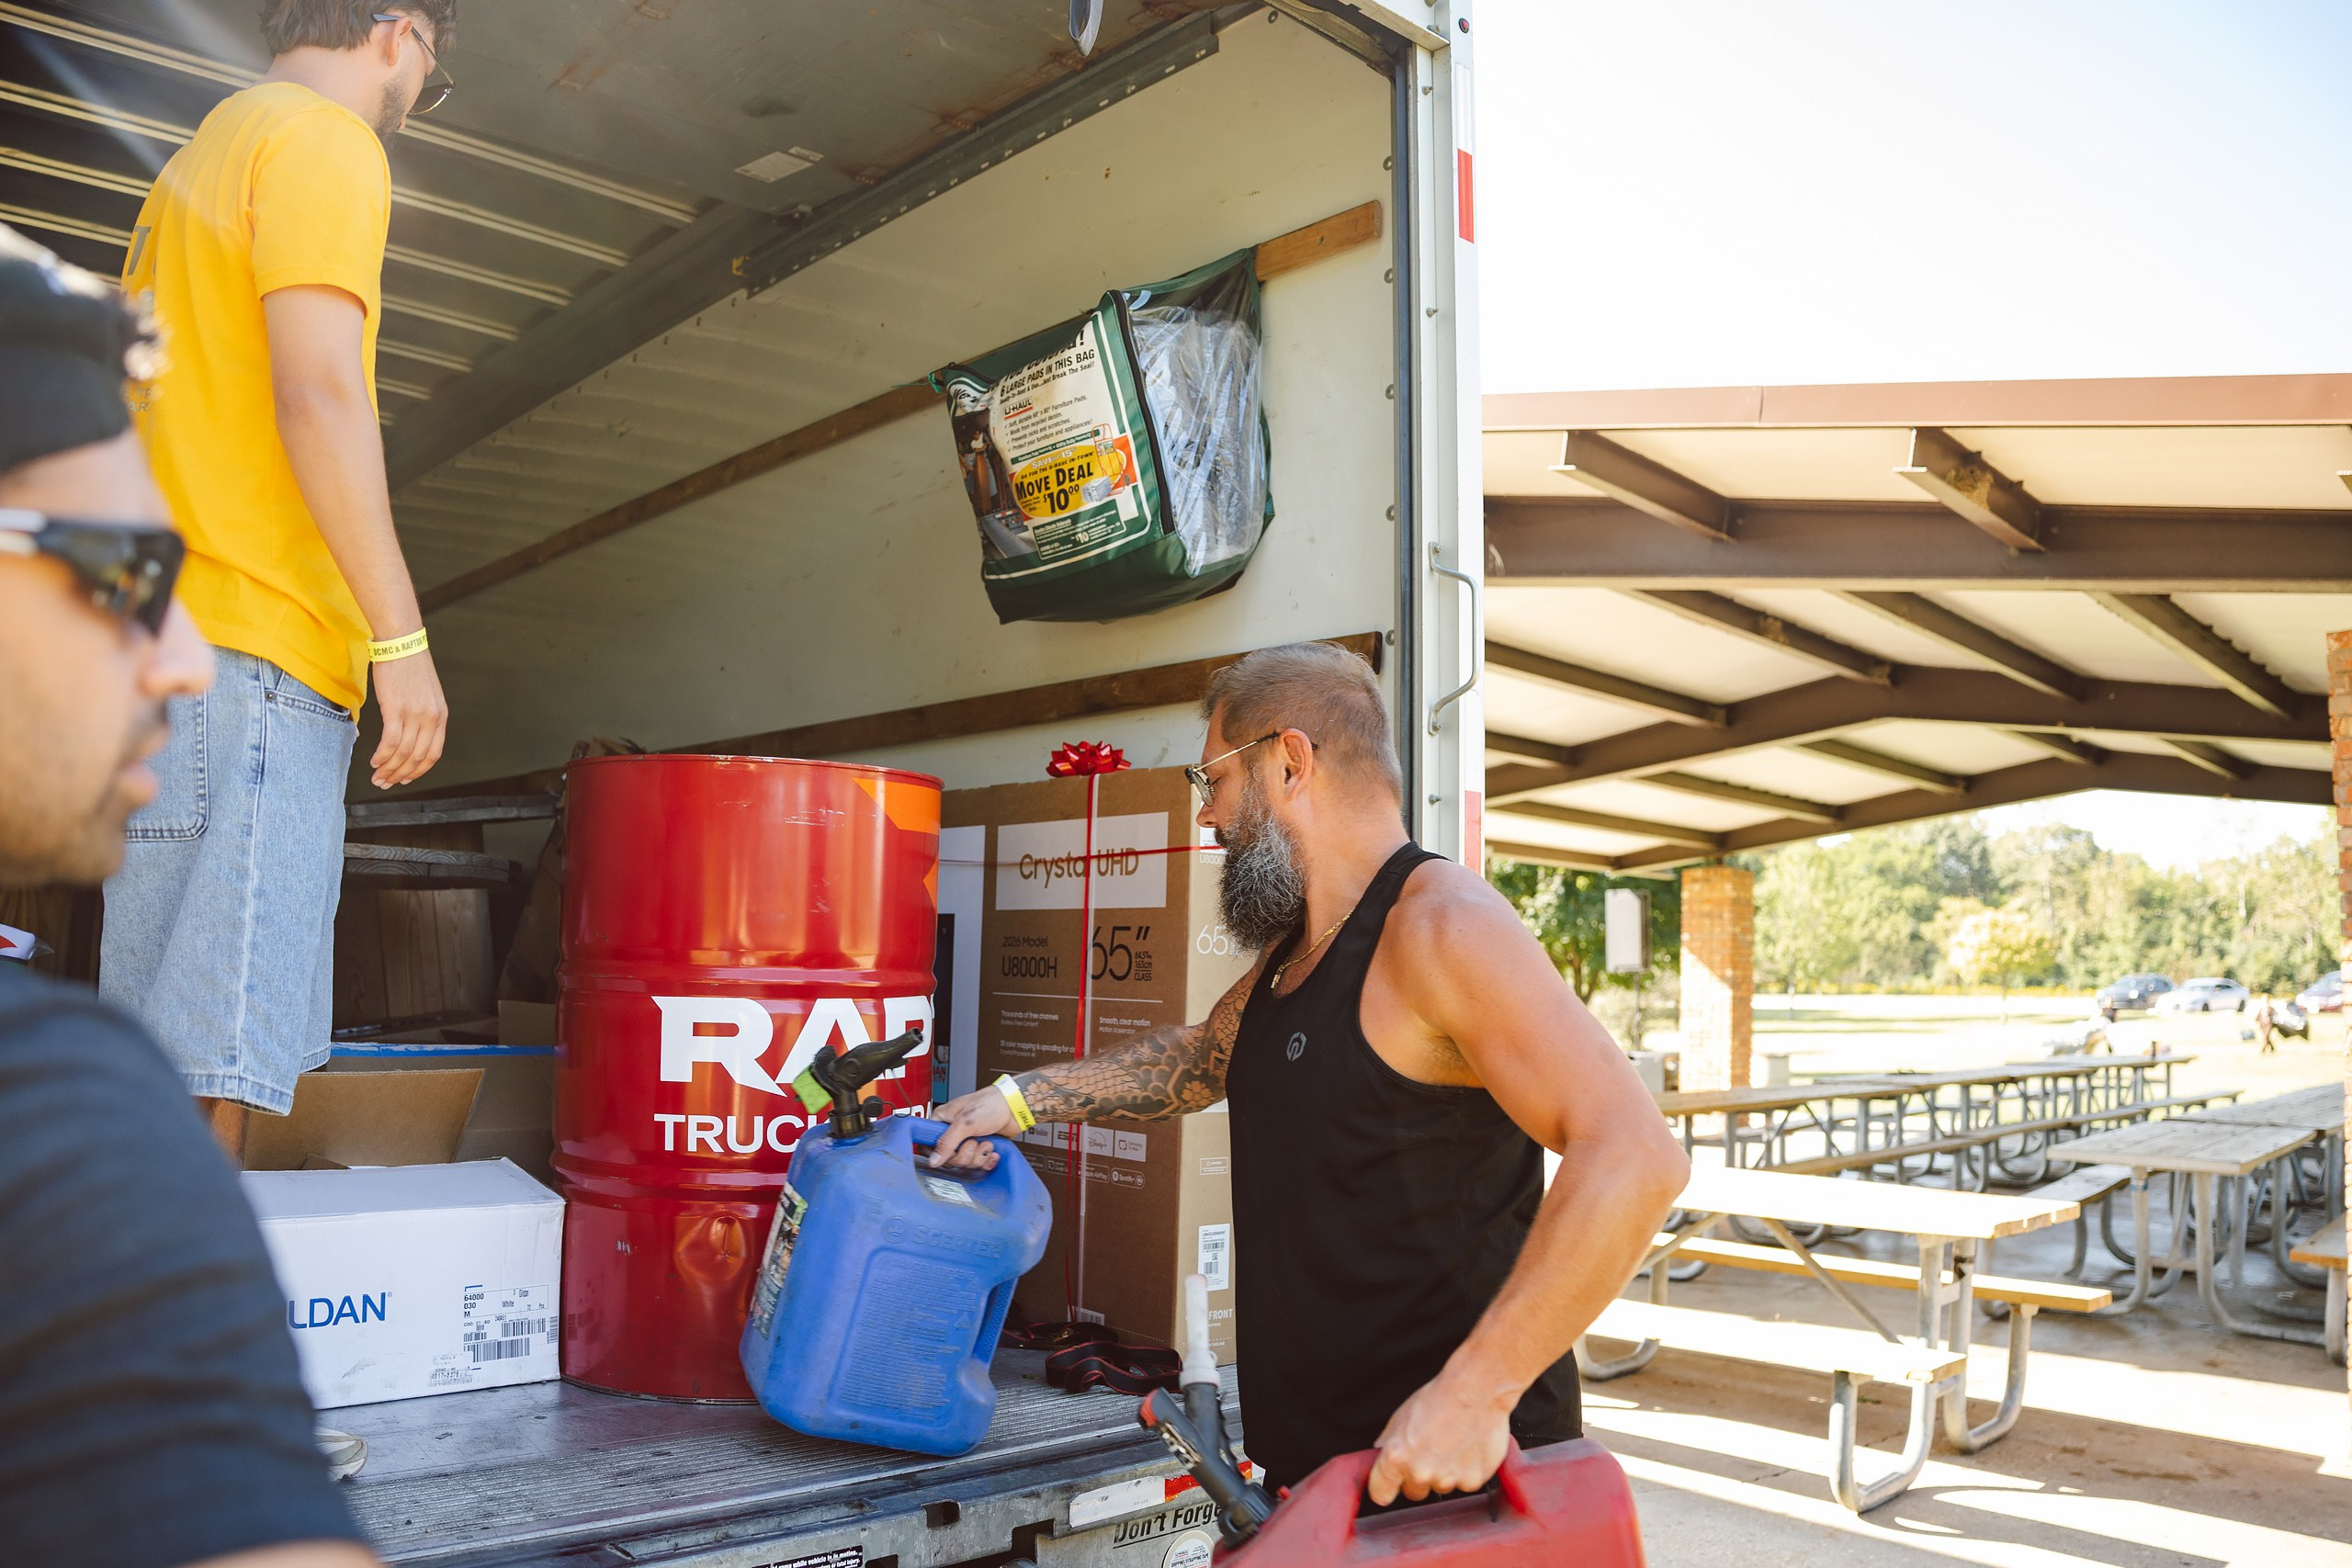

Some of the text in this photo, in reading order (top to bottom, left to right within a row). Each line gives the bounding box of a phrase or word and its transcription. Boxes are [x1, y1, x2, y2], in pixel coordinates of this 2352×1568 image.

[1001, 349, 1094, 397] 6 LARGE PADS IN THIS BAG
[1052, 371, 1067, 381] Break
[1069, 367, 1079, 375] The
[1052, 399, 1073, 411] Furniture
[1074, 395, 1088, 403] Pads.
[1012, 433, 1027, 443] Prevents
[1048, 418, 1070, 429] scratches.
[1012, 442, 1026, 451] Protect
[1036, 433, 1054, 442] furniture
[1065, 418, 1092, 433] appliances!
[1032, 457, 1052, 468] SAVE
[1039, 466, 1047, 474] THE
[1015, 462, 1093, 501] MOVE DEAL
[1019, 847, 1139, 888] Crysta UHD
[1022, 935, 1048, 948] Model
[1002, 955, 1057, 979] U8000H
[1134, 972, 1152, 982] CLASS
[1133, 1019, 1151, 1027] motion
[650, 994, 934, 1097] RAP
[911, 1225, 1001, 1259] SCEPTER
[464, 1293, 484, 1302] 64000
[288, 1292, 386, 1329] LDAN
[464, 1302, 477, 1310] 030
[1208, 1308, 1233, 1320] FRONT
[1114, 1501, 1223, 1544] Don't Forge
[808, 1556, 827, 1565] vehicle
[839, 1550, 858, 1558] motion.
